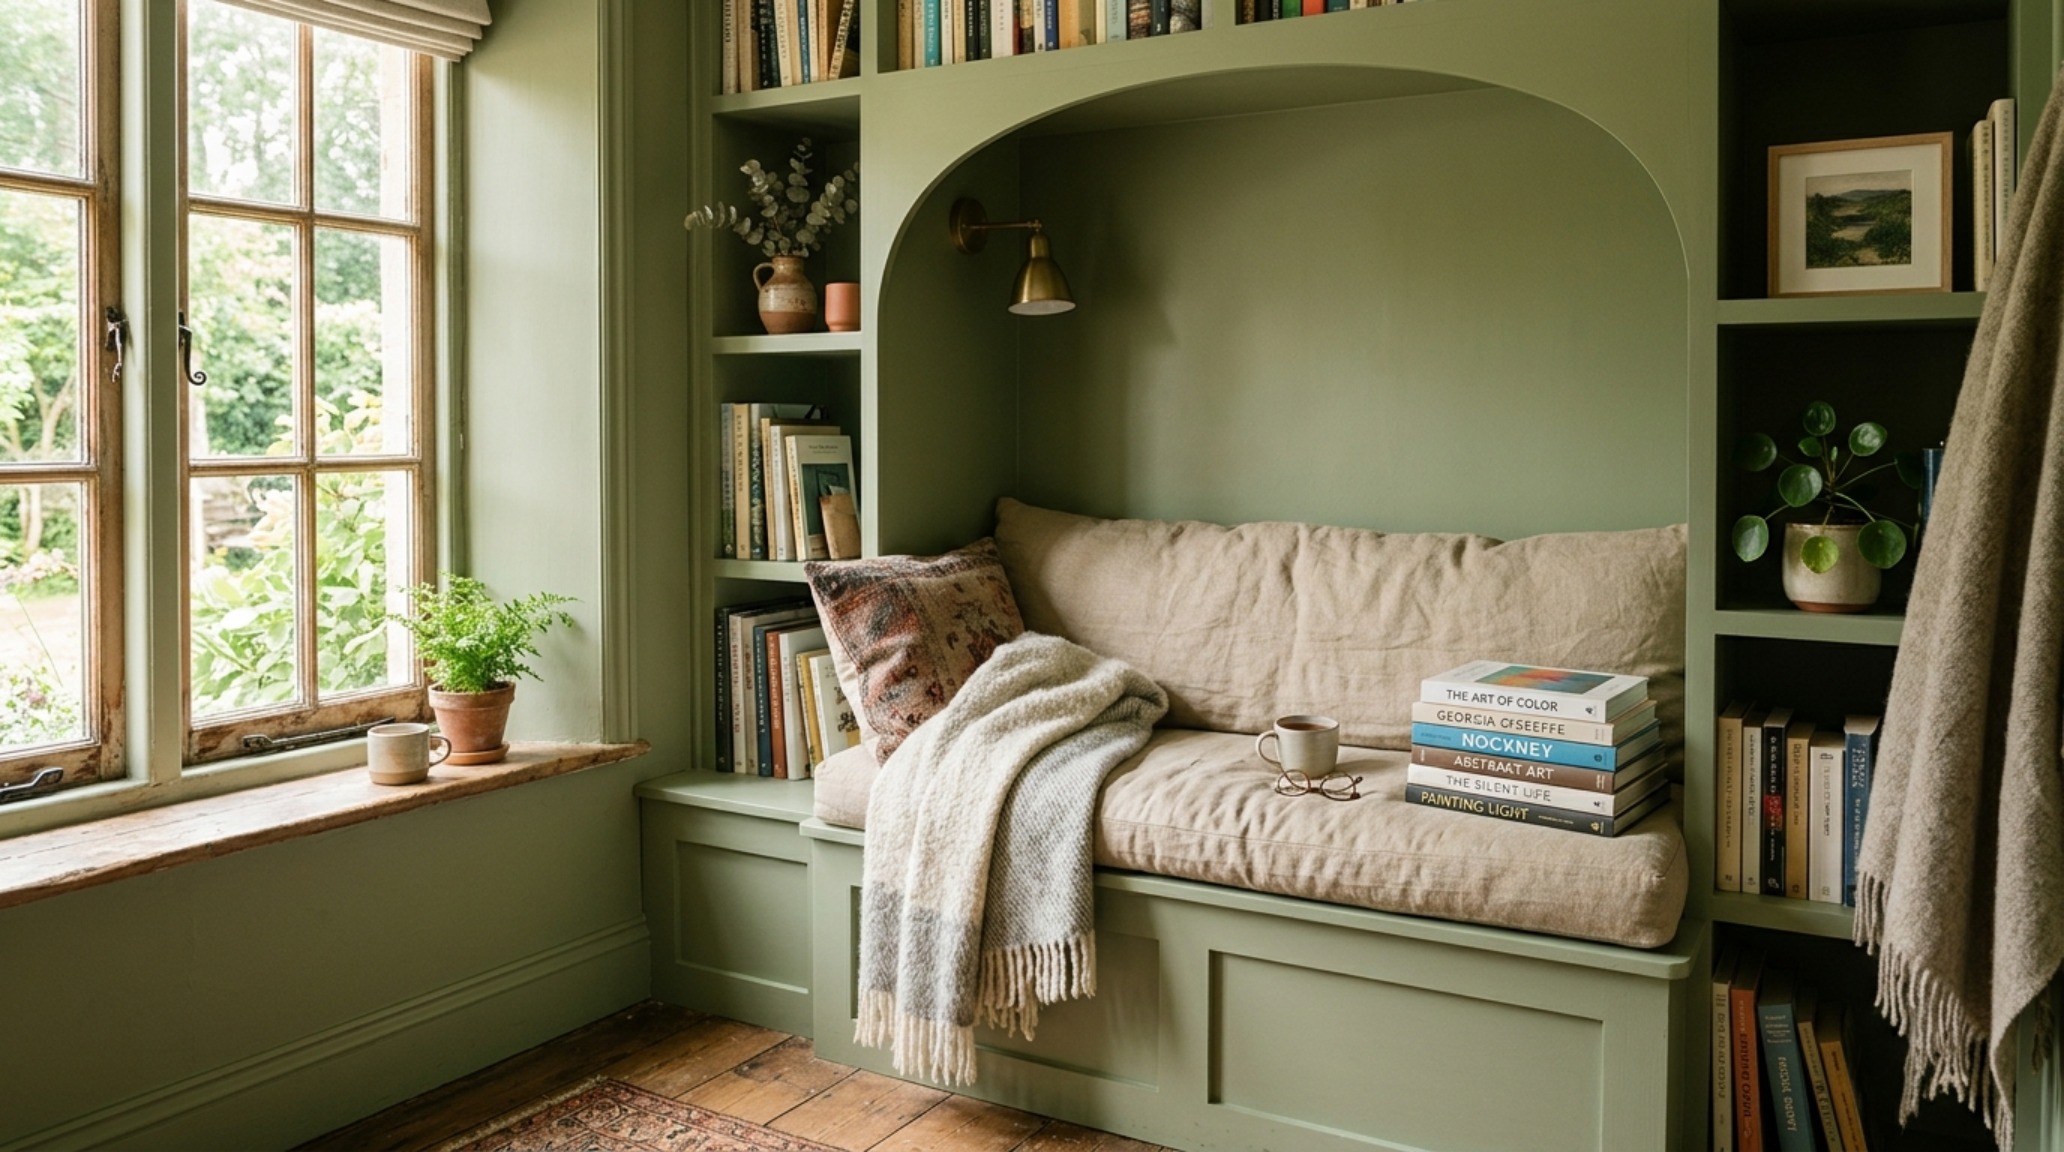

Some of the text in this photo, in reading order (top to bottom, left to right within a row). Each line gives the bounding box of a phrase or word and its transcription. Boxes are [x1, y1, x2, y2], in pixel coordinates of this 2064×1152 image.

[1446, 689, 1558, 712] THE ART OF COLOR
[1525, 766, 1555, 780] ART
[1446, 775, 1471, 788] THE
[1474, 779, 1519, 796] SILENT
